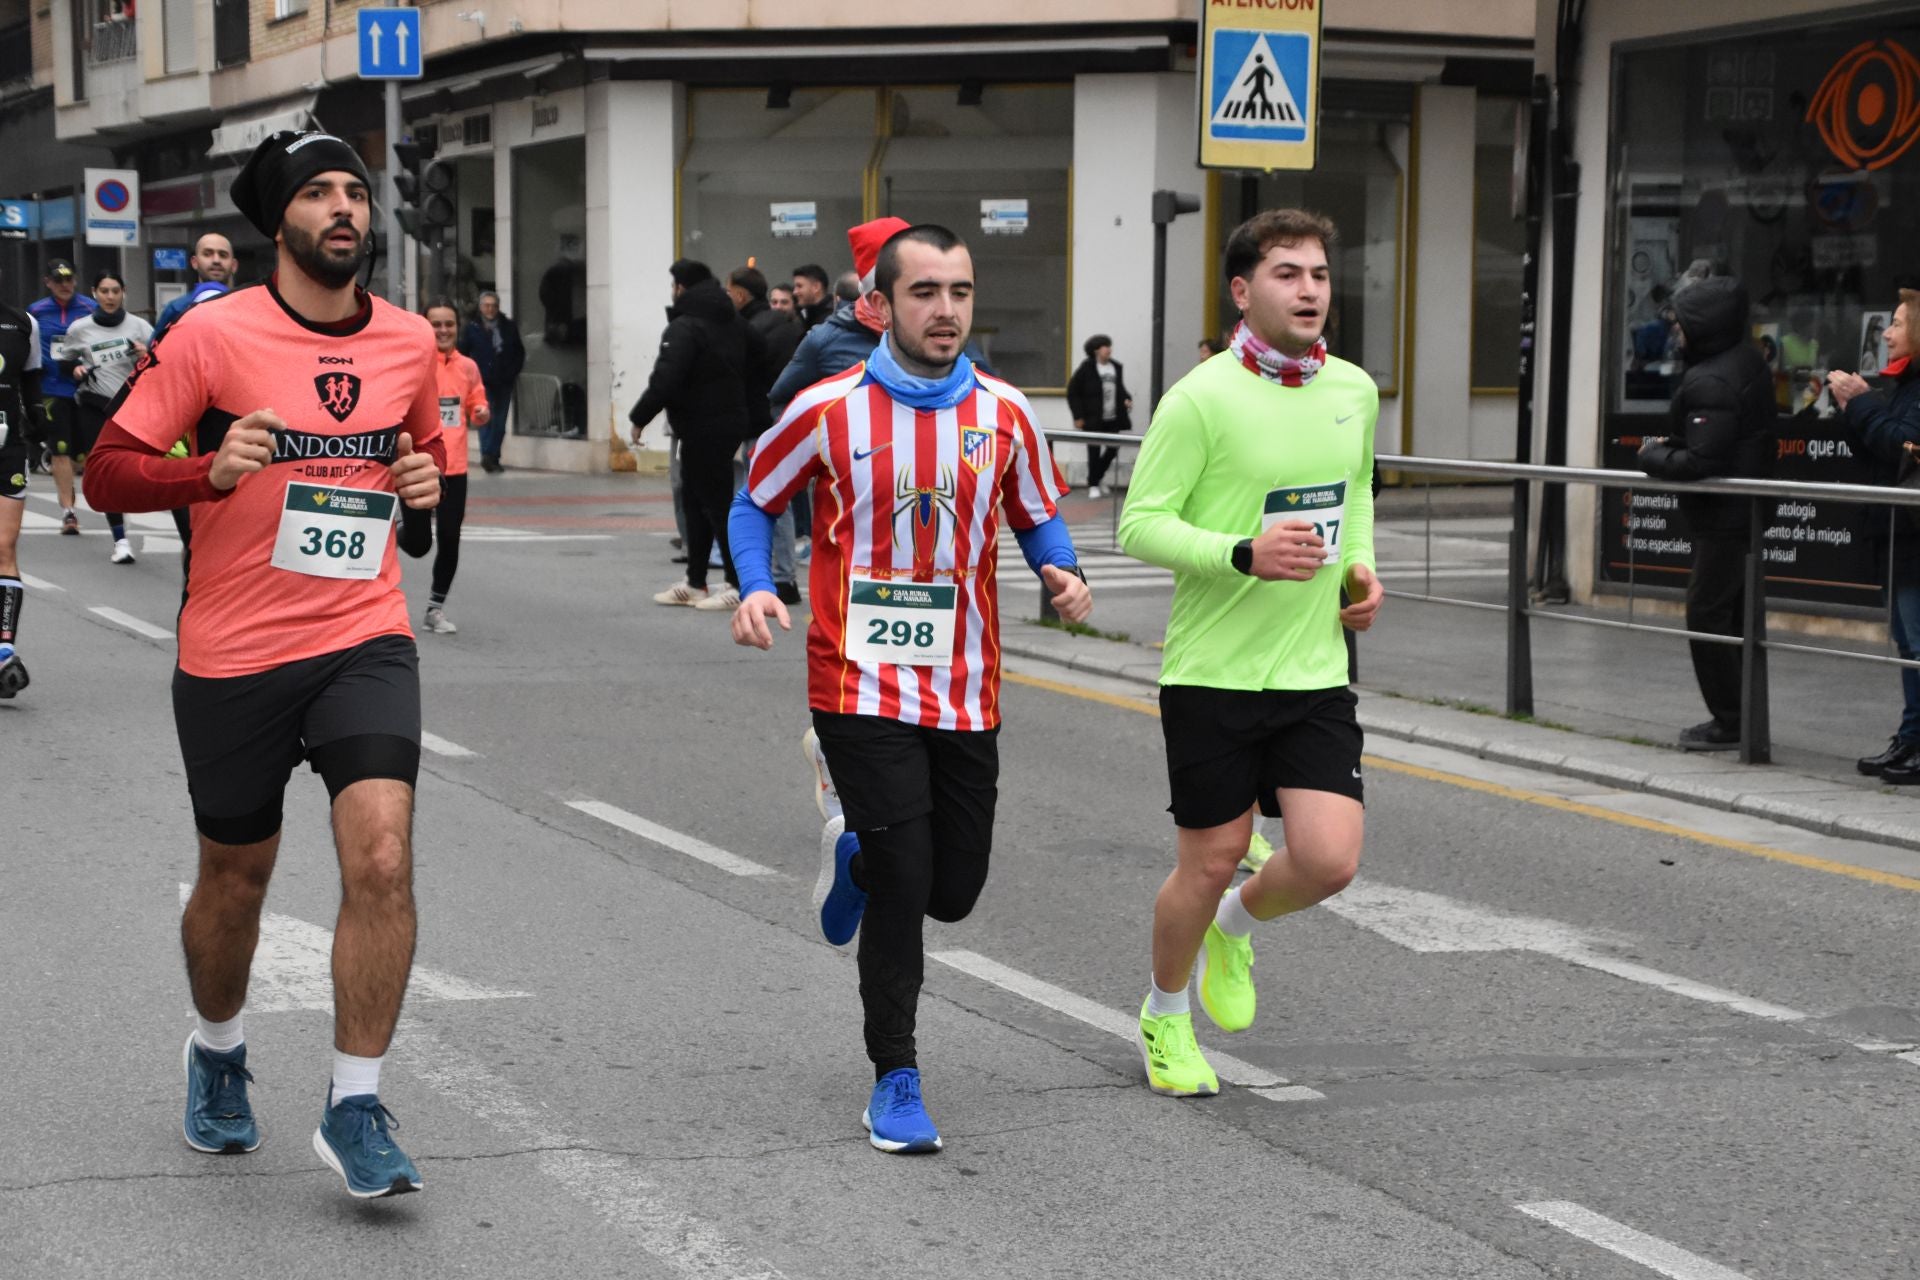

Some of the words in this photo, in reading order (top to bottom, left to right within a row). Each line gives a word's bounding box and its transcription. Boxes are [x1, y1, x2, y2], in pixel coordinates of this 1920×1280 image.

[99, 350, 122, 362] 218
[1807, 439, 1835, 460] que
[305, 465, 328, 478] CLUB
[1641, 514, 1667, 530] visión
[299, 526, 367, 561] 368
[1792, 524, 1806, 541] de
[1806, 525, 1816, 542] la
[1817, 527, 1852, 546] miopía
[1648, 537, 1692, 555] especiales
[1769, 546, 1797, 563] visual
[903, 596, 932, 604] NAVARRA
[909, 590, 929, 598] RURAL
[866, 618, 934, 648] 298
